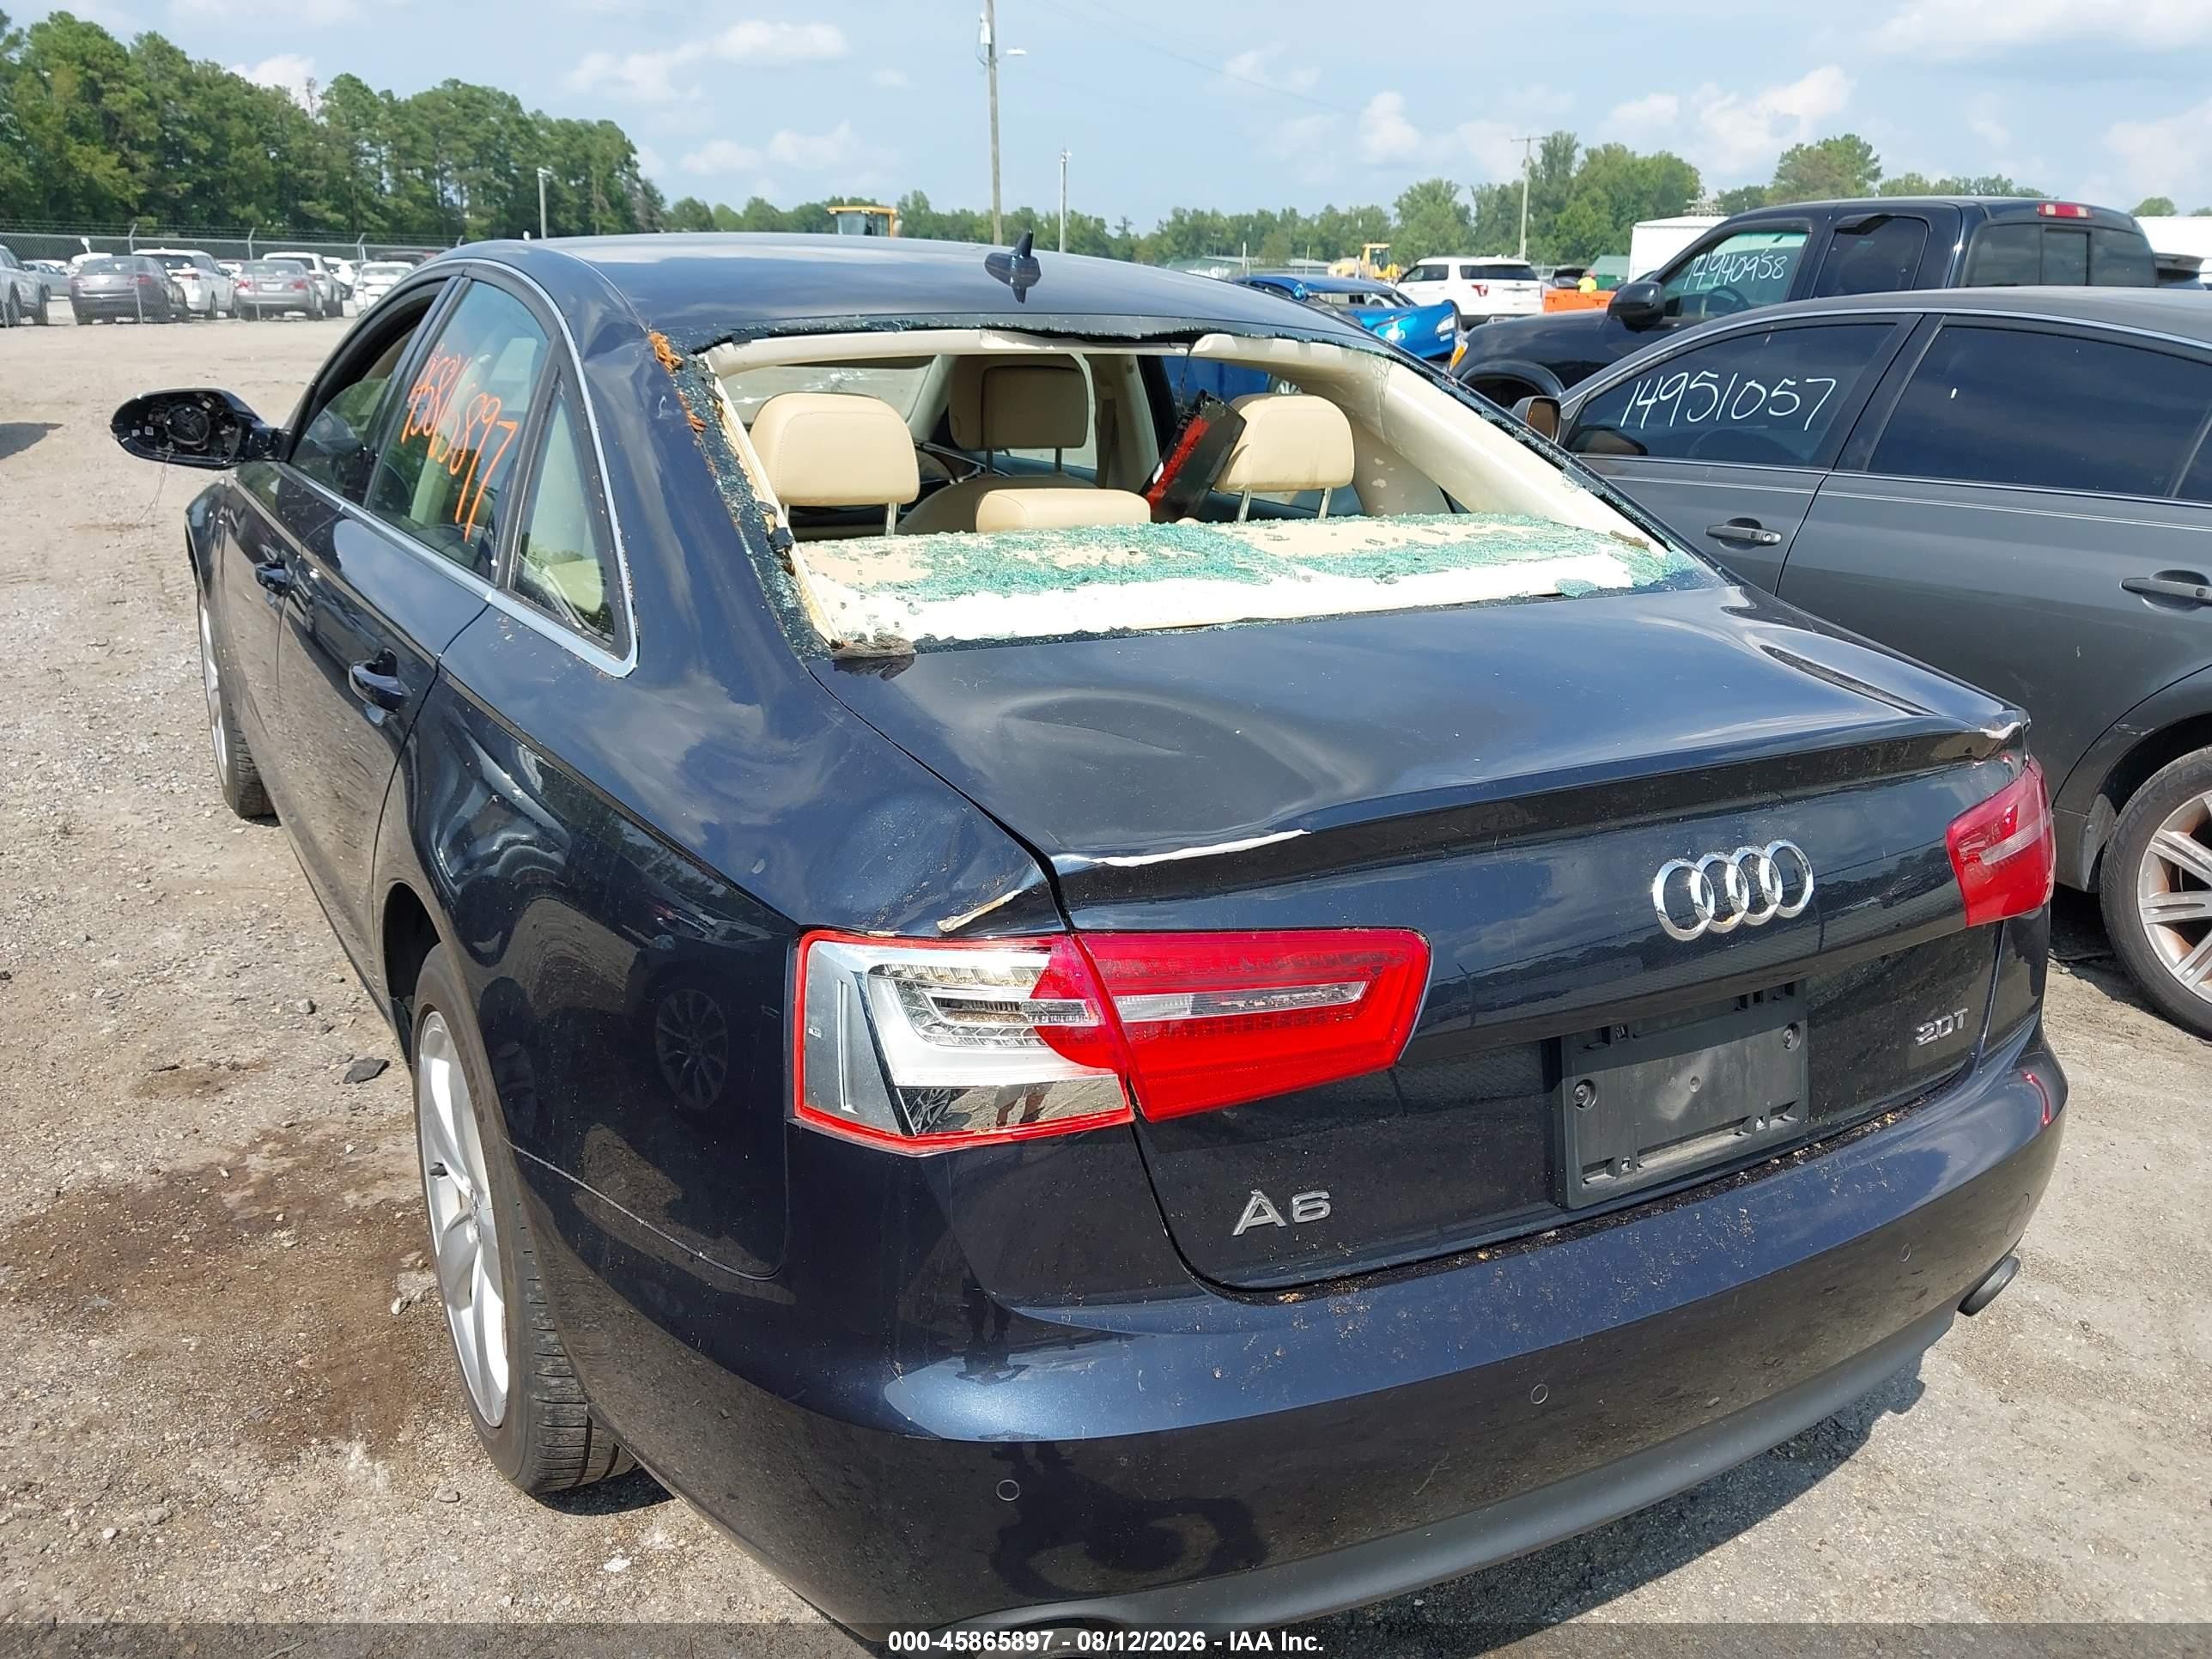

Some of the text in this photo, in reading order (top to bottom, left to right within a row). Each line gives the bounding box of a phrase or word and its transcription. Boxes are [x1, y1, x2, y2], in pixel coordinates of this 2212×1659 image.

[1683, 248, 1788, 290] 14940958
[1620, 370, 1837, 431] 14951057
[1232, 1188, 1331, 1236] A6
